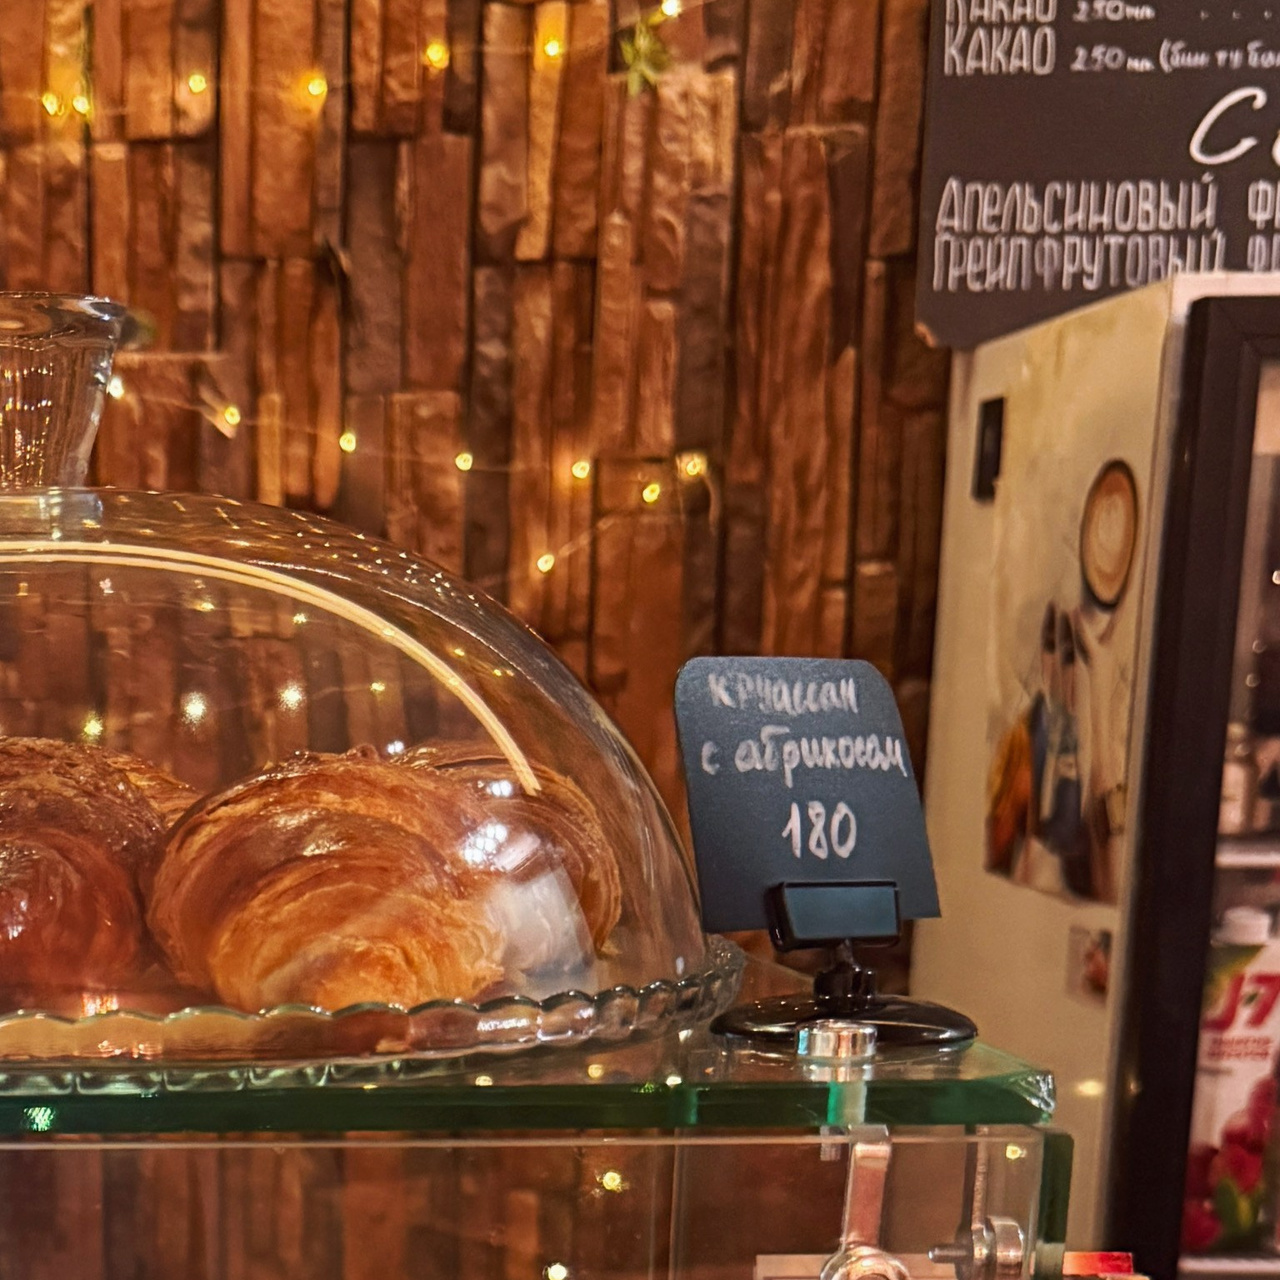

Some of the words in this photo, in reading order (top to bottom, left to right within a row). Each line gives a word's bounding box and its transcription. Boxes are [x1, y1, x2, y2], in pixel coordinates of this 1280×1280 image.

[1247, 40, 1280, 69] ба
[1189, 86, 1280, 166] С
[1247, 179, 1280, 231] Ф
[781, 801, 857, 859] 180
